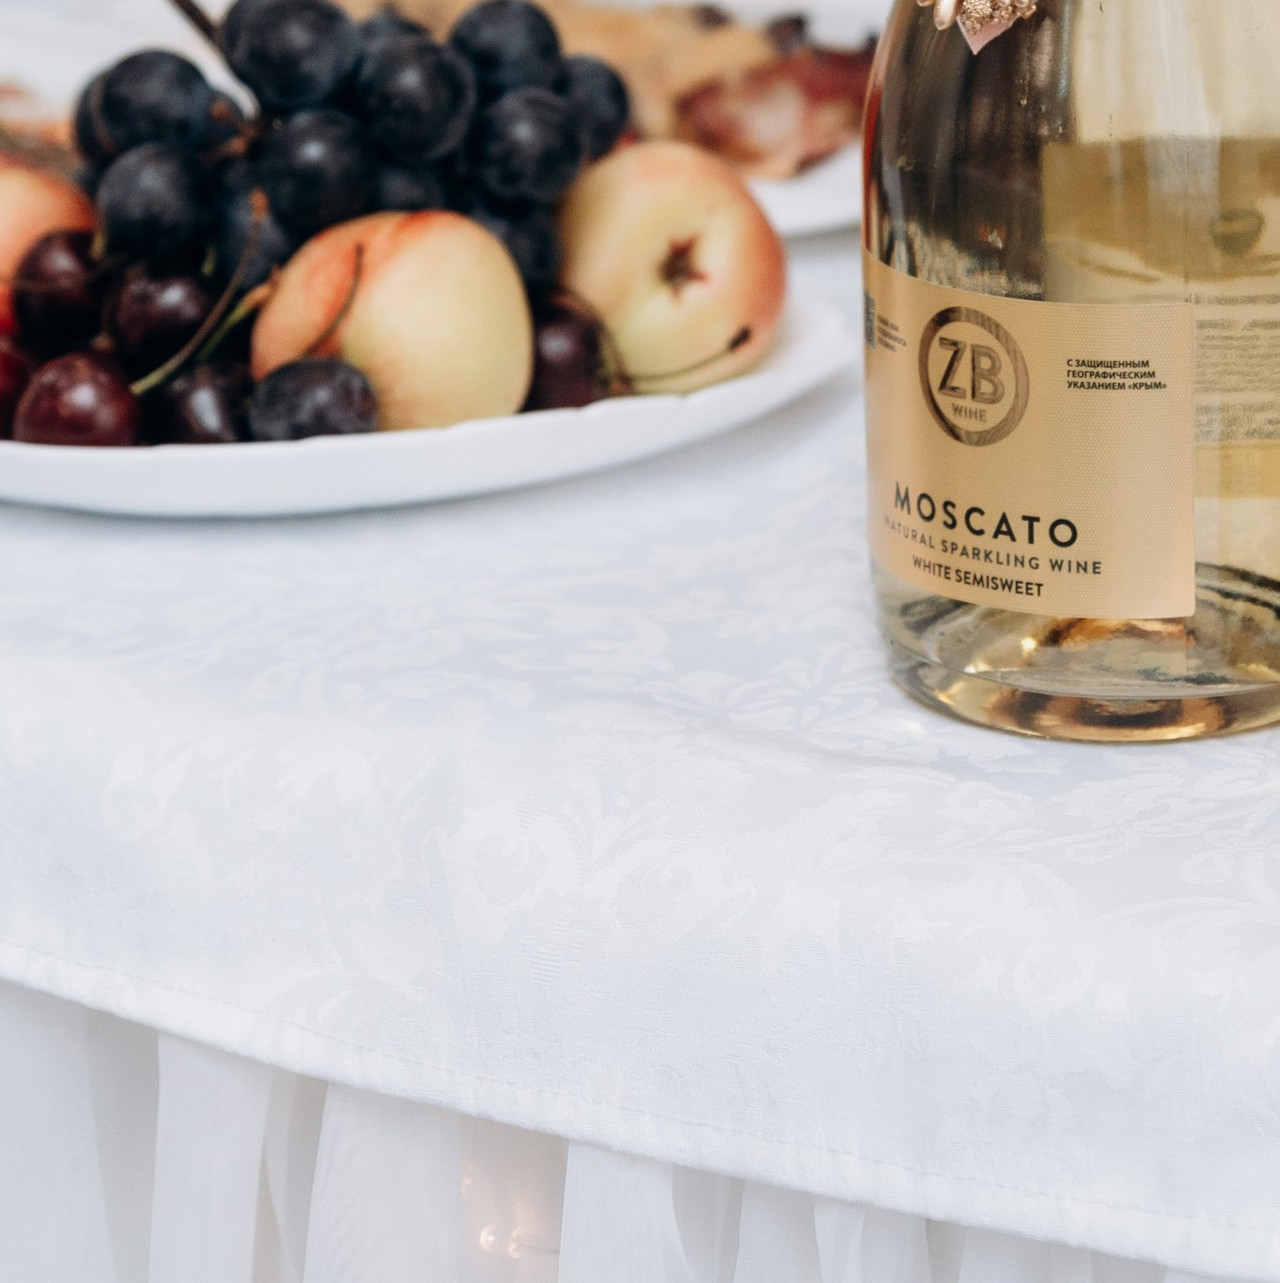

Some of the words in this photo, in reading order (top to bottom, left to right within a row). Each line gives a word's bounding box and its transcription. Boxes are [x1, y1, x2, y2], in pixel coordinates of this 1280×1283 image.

[938, 337, 1005, 405] ZB
[1066, 359, 1073, 367] С
[1075, 359, 1150, 369] ЗАЩИЩЕННЫМ
[1067, 370, 1156, 379] ГЕОГРАФИЧЕСКИМ
[1067, 381, 1126, 390] УКАЗАНИЕМ
[1128, 381, 1167, 390] «КРЫМ»
[952, 403, 987, 422] WINE
[894, 481, 1078, 548] MOSCATO
[884, 515, 935, 549] NATURAL
[940, 539, 1040, 570] SPARKLING
[1049, 558, 1103, 575] WINE
[912, 554, 952, 581] WHITE
[955, 568, 1044, 597] SEMISWEET
